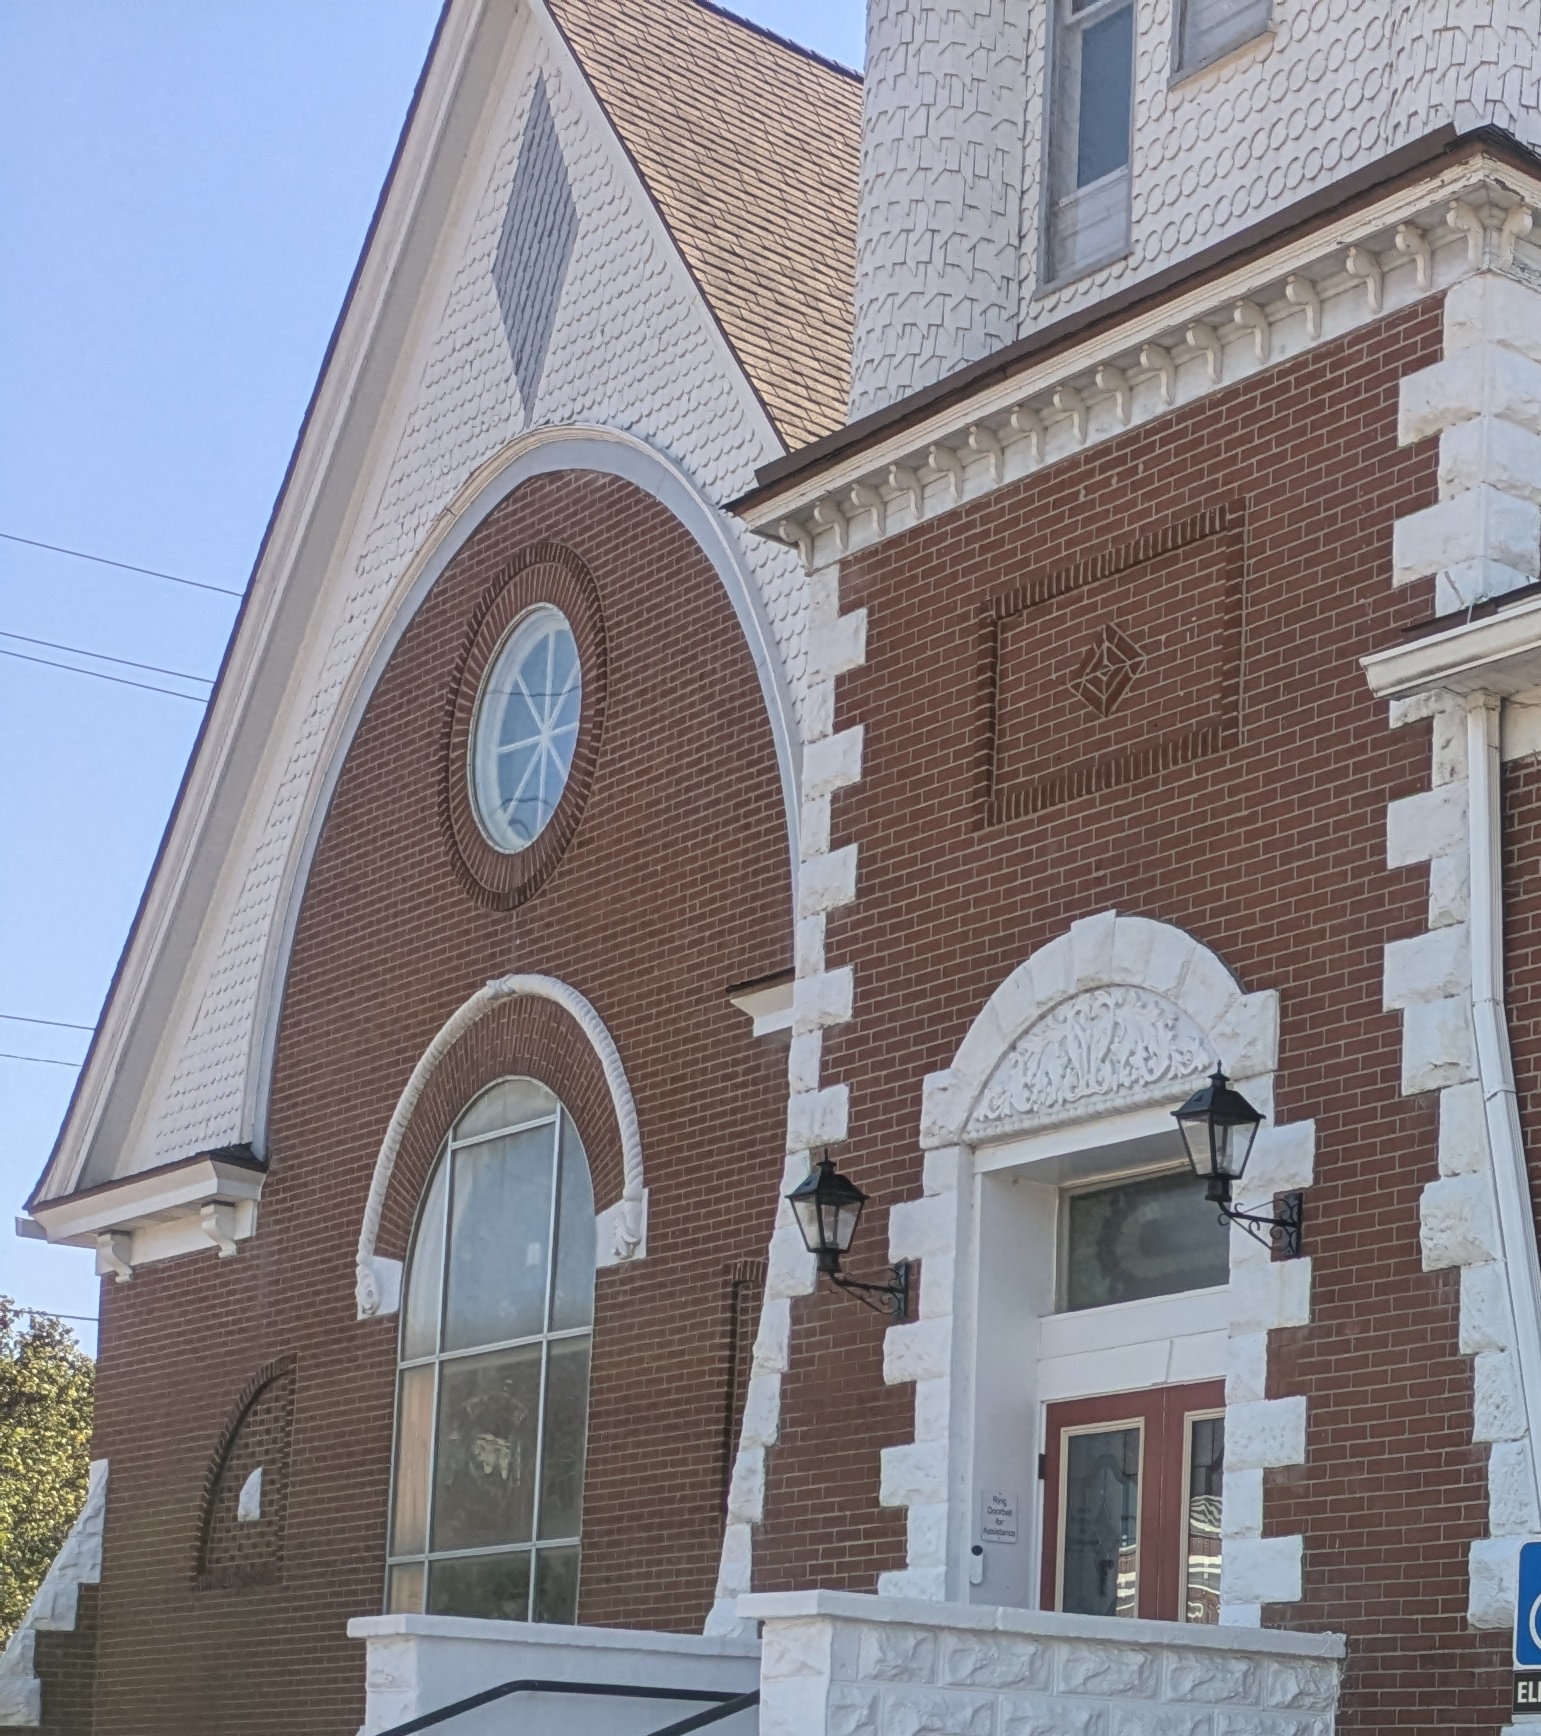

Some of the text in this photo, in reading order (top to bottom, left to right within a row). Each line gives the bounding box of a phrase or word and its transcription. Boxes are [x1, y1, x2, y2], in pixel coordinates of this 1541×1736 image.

[993, 1496, 1007, 1507] Ring
[987, 1506, 1013, 1516] Doorbell
[996, 1517, 1005, 1525] for
[983, 1527, 1016, 1537] Assistance
